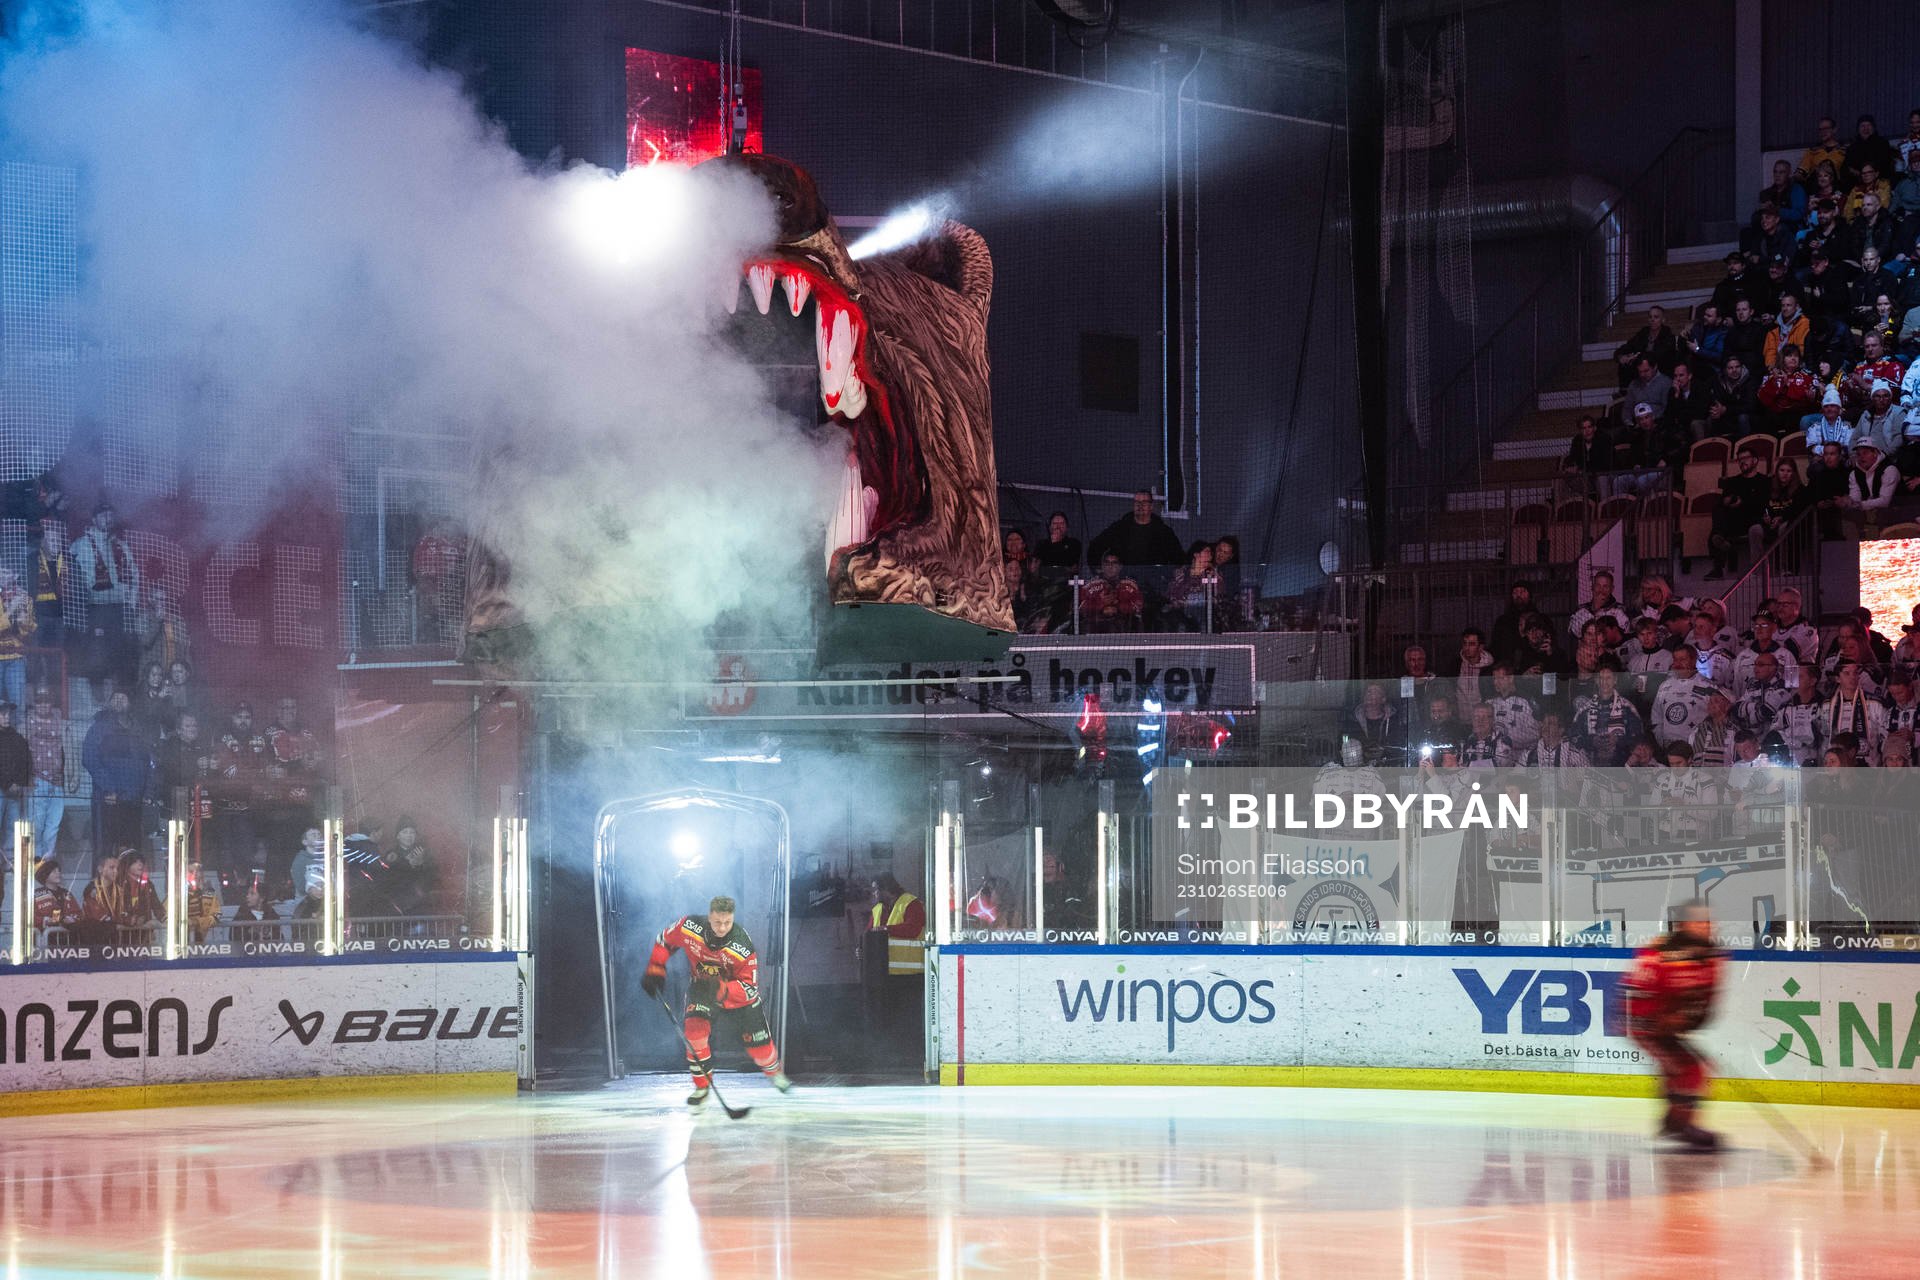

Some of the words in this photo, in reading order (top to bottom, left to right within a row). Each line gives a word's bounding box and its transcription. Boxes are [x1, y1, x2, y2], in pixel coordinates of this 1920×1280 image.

[1049, 657, 1217, 712] hockey
[1494, 857, 1540, 870] WE
[1600, 854, 1685, 871] WHAT
[1700, 849, 1748, 864] WE
[683, 919, 703, 934] SSAB
[45, 948, 90, 959] NYAB
[117, 946, 162, 957] NYAB
[187, 944, 232, 955] NYAB
[259, 942, 305, 953] NYAB
[403, 939, 450, 950] NYAB
[991, 931, 1036, 942] NYAB
[1134, 931, 1180, 942] NYAB
[1202, 931, 1247, 942] NYAB
[1285, 931, 1330, 943] NYAB
[1353, 931, 1397, 943] NYAB
[1433, 932, 1476, 943] NYAB
[1498, 932, 1541, 943] NYAB
[1574, 933, 1617, 944] NYAB
[1849, 937, 1895, 948] NYAB
[730, 942, 751, 958] SSAB
[1056, 964, 1277, 1053] winpos
[0, 995, 233, 1064] nzens
[1516, 1044, 1558, 1057] bästa
[1563, 1049, 1581, 1058] av
[1586, 1047, 1645, 1062] betong.
